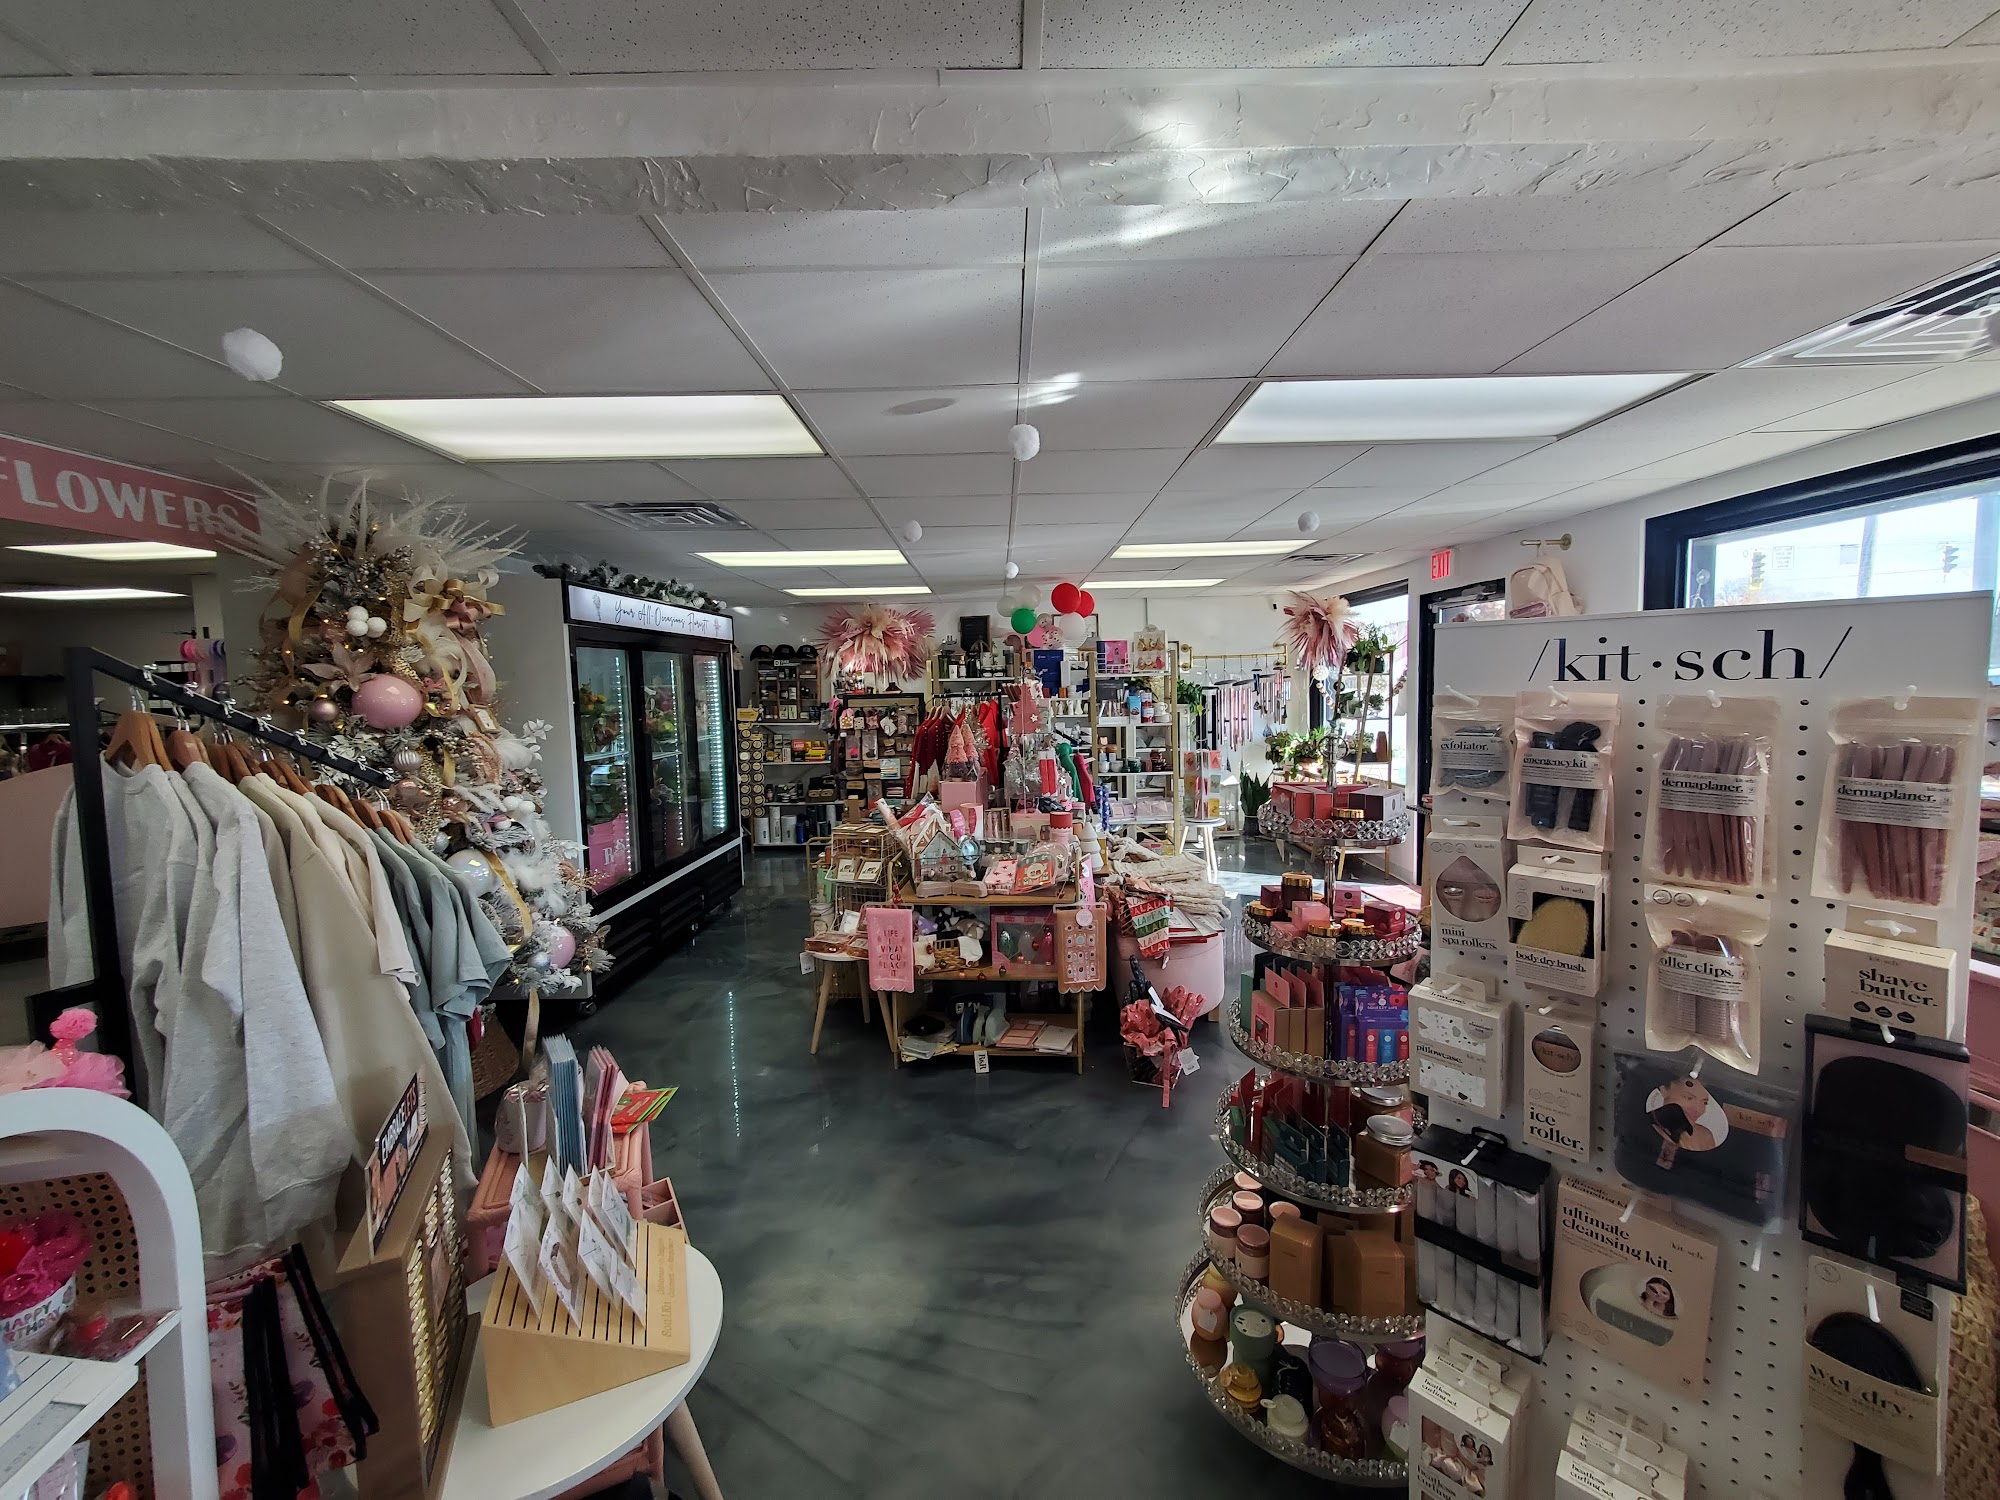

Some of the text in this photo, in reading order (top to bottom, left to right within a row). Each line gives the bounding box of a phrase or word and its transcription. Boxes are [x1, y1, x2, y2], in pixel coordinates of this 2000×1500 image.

[1431, 550, 1451, 579] EXIT
[614, 600, 635, 623] Your
[1440, 740, 1489, 751] exfoliator.
[1523, 757, 1587, 768] emergency kit
[1661, 777, 1744, 793] dermaplaner.
[1837, 785, 1937, 803] dermaplaner.
[883, 929, 899, 937] LIFE
[1441, 926, 1465, 937] mini
[1442, 937, 1498, 950] spa rollers.
[1515, 950, 1587, 972] body dry brush.
[1694, 962, 1735, 978] clips.
[1859, 968, 1928, 992] shave
[1860, 979, 1938, 1007] butter.
[1530, 1106, 1556, 1126] ice
[1530, 1125, 1585, 1151] roller.
[1563, 1206, 1630, 1240] ultimate
[1562, 1218, 1642, 1261] cleansing
[1645, 1250, 1673, 1273] kit.
